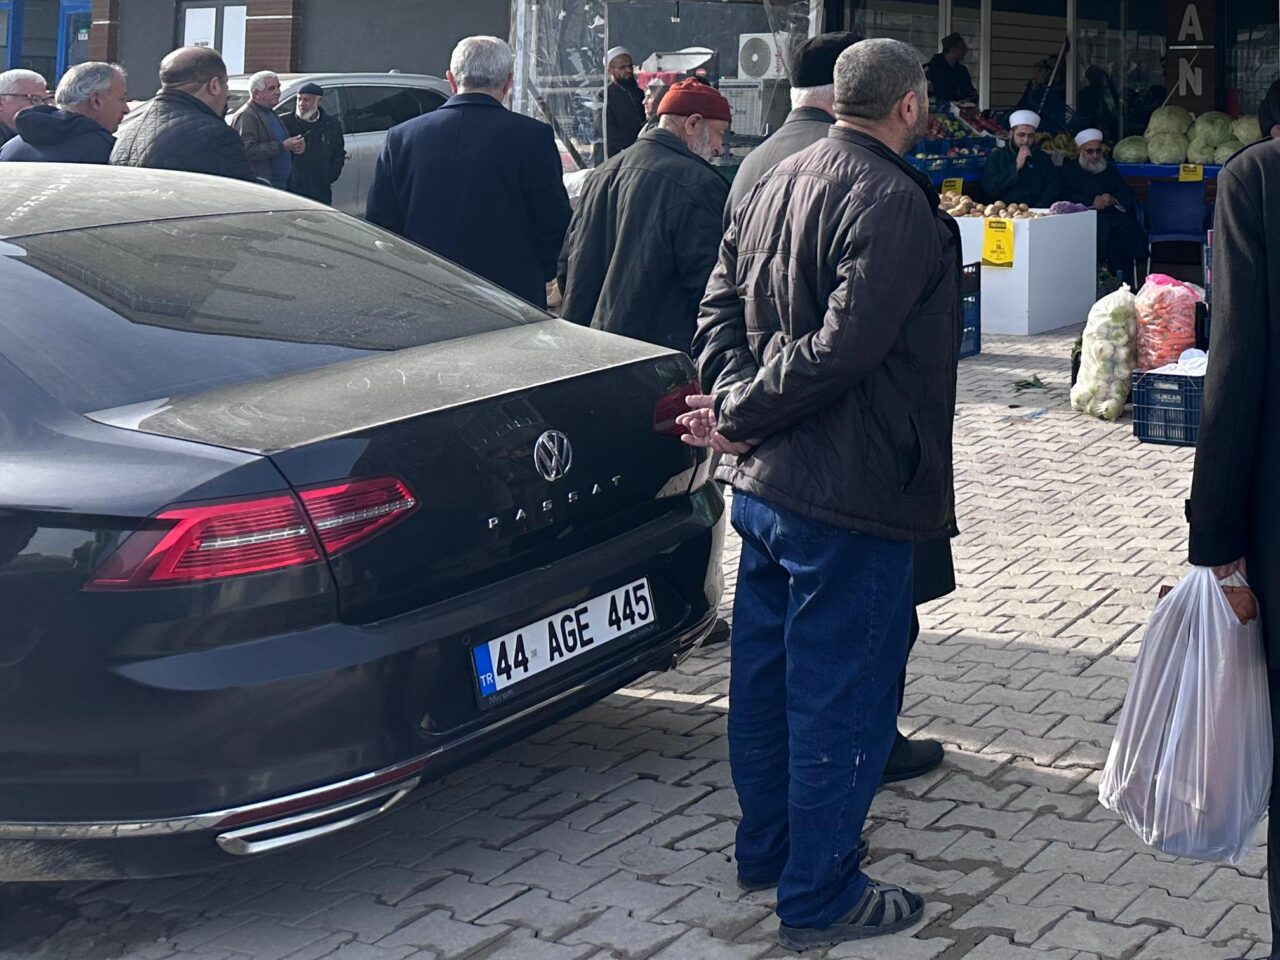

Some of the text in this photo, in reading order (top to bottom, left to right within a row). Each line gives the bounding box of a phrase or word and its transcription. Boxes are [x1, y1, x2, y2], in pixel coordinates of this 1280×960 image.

[488, 474, 622, 529] PASSAT
[480, 582, 650, 687] TR 44 AGE 445
